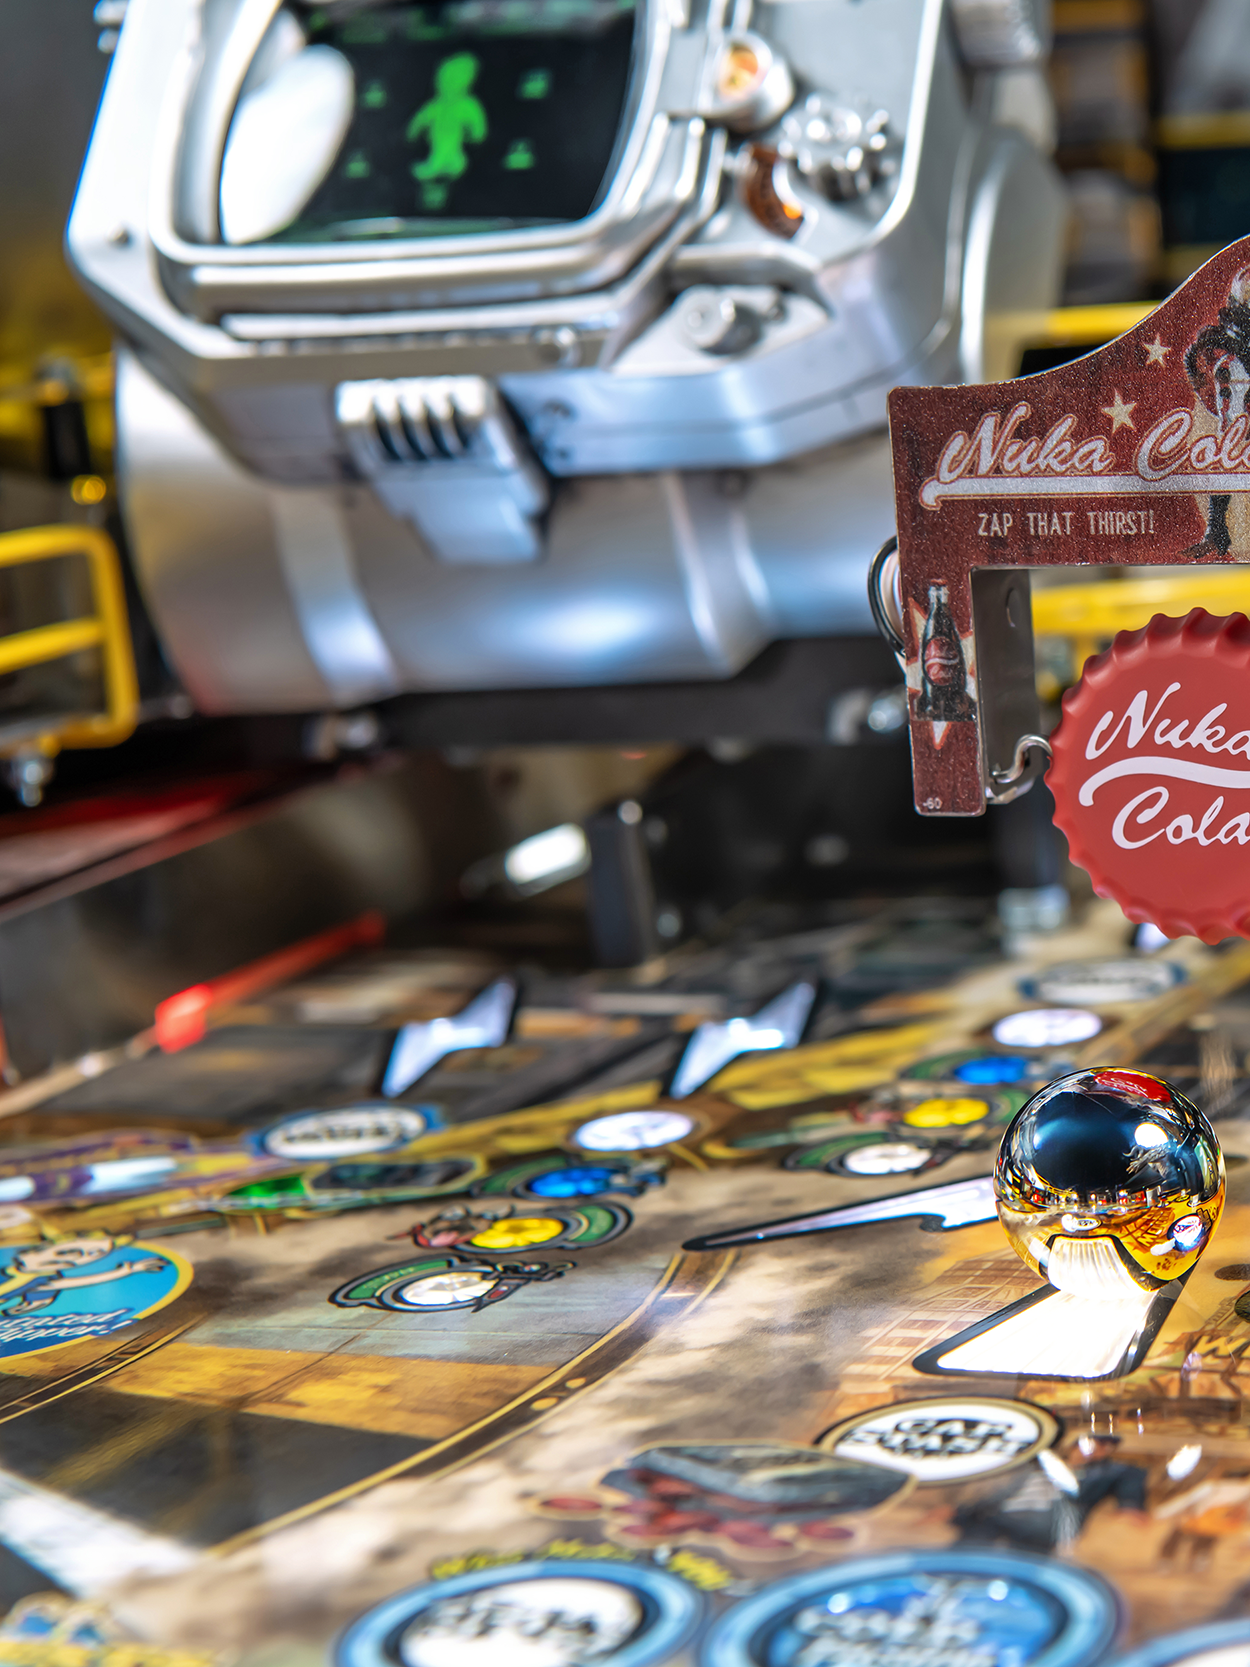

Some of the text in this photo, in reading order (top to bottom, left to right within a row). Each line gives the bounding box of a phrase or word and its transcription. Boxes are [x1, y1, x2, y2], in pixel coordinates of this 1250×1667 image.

[936, 401, 1115, 483] Nuka
[978, 509, 1155, 537] ZAP THAT THIRST!
